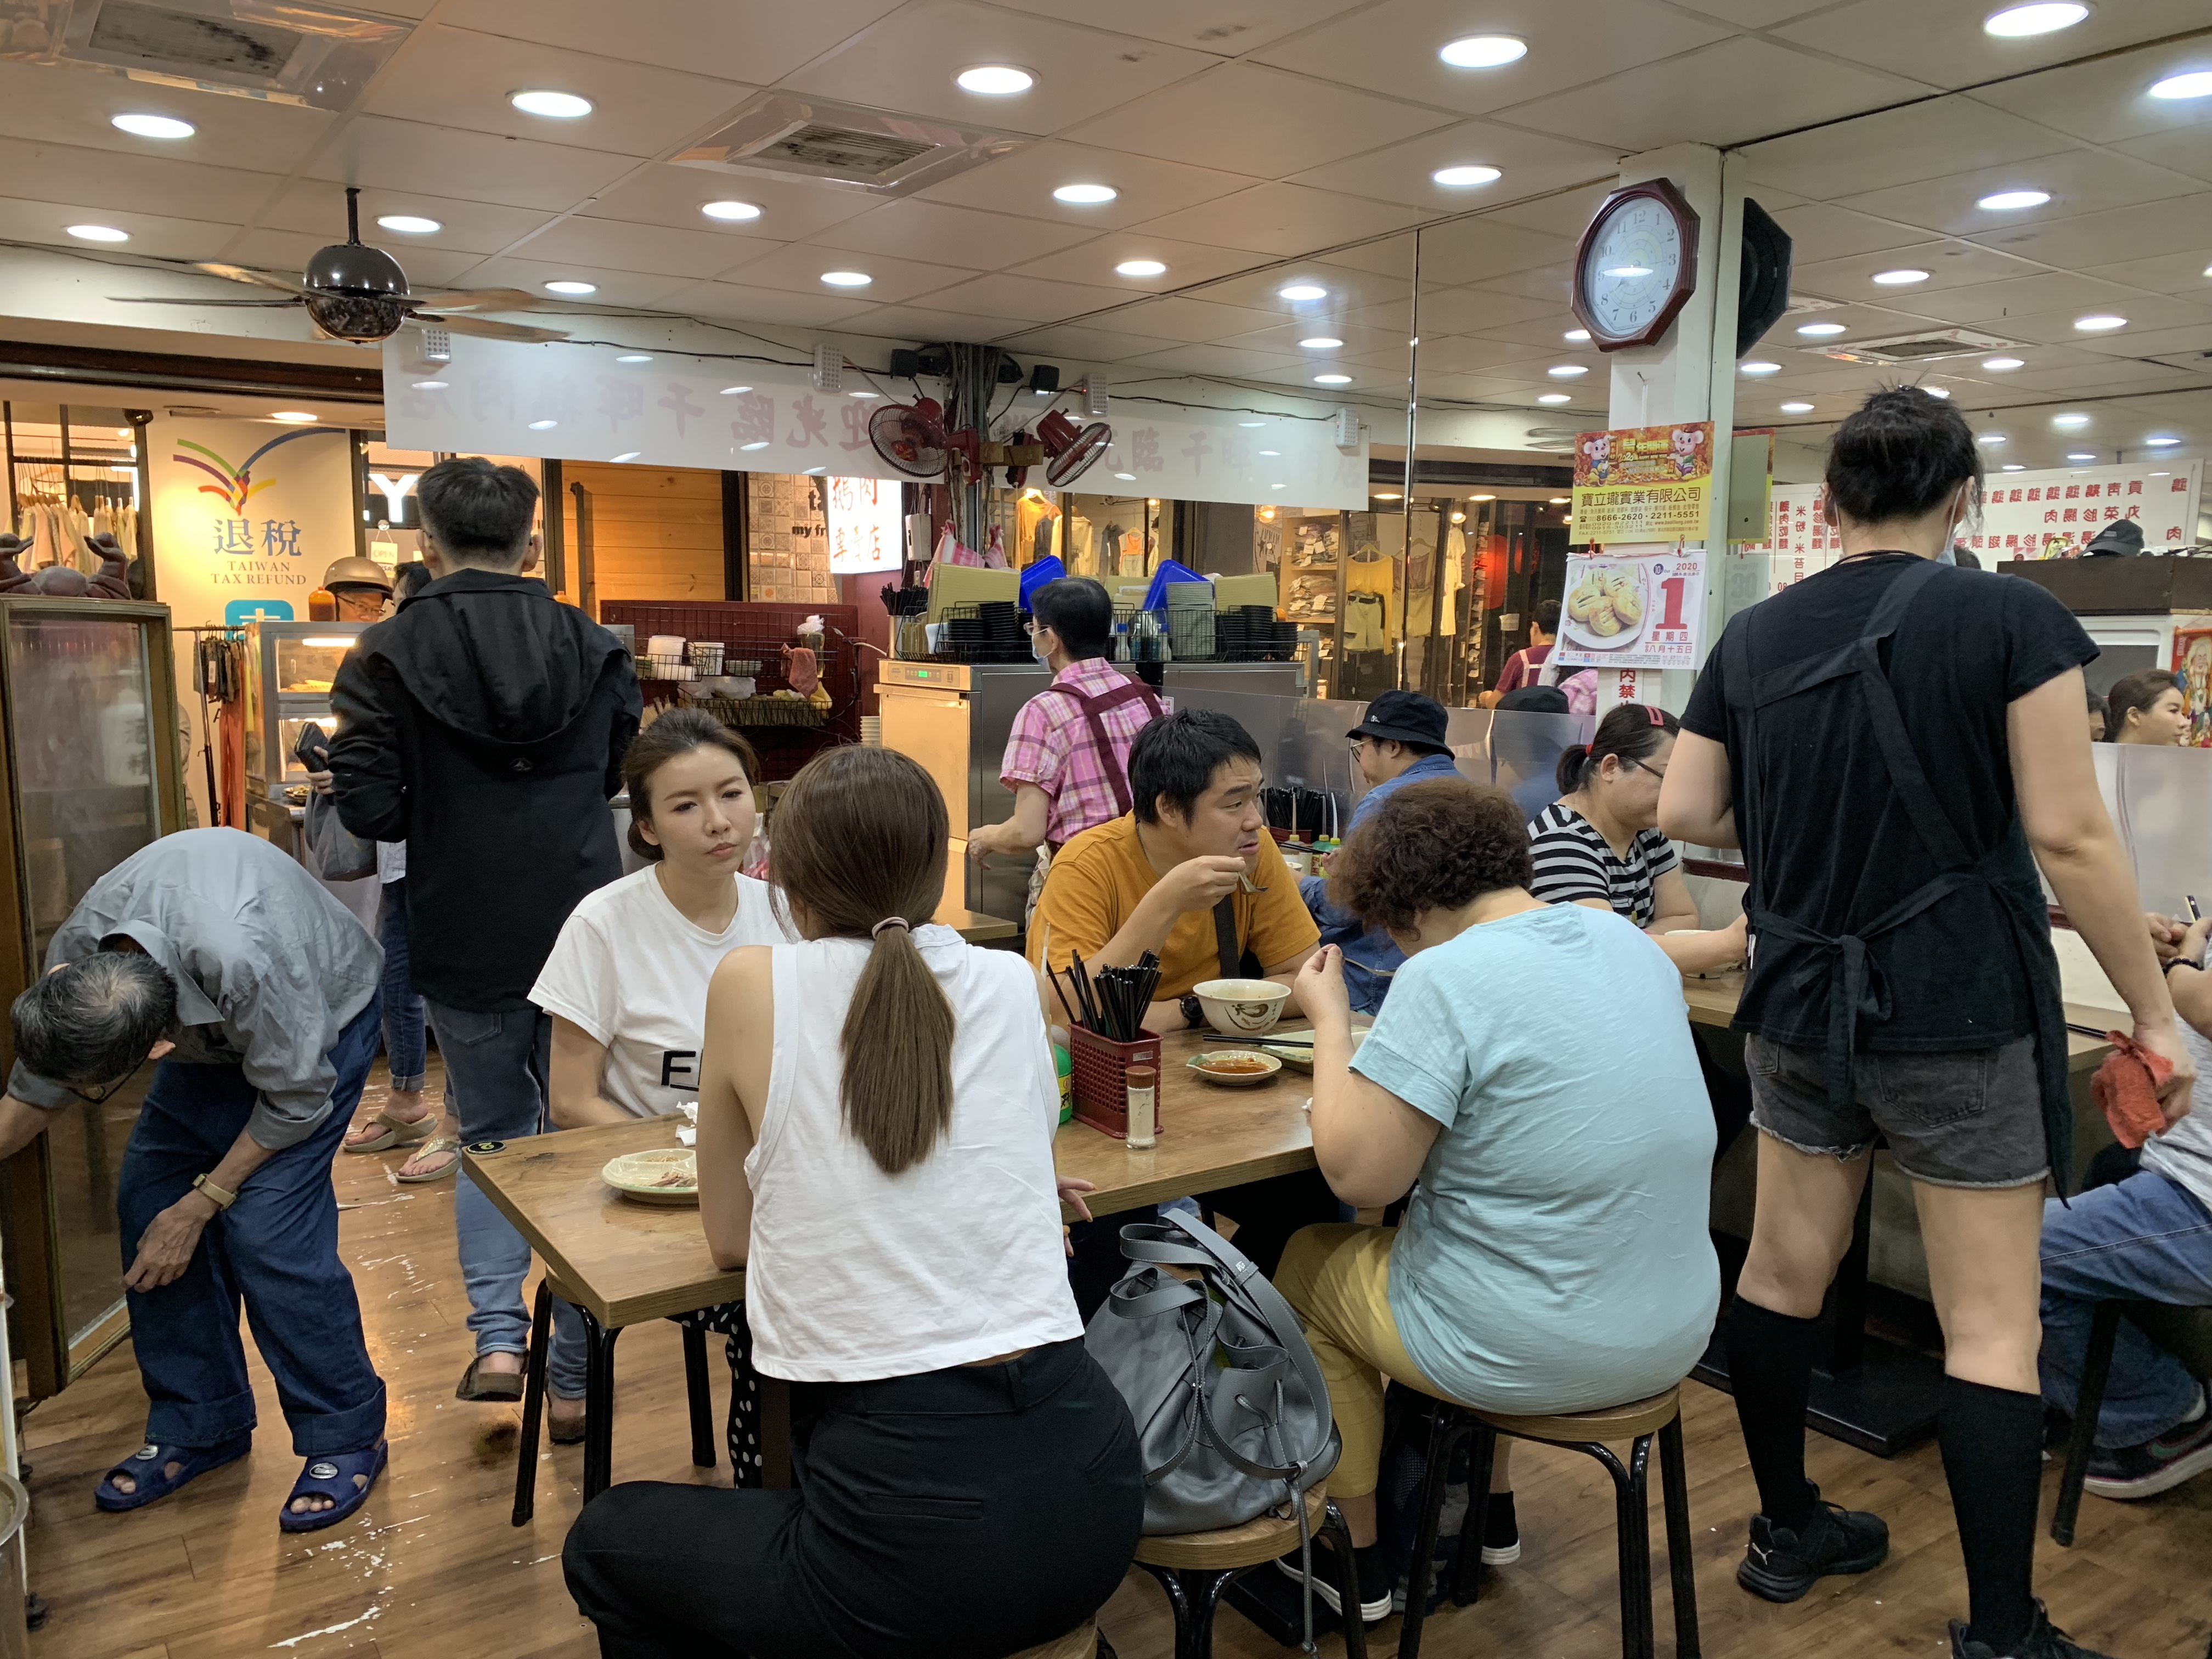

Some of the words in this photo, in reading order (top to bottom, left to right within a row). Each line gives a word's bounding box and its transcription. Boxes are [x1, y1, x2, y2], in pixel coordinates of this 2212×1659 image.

[1633, 210, 1646, 224] 12
[1656, 213, 1660, 225] 1
[1617, 221, 1627, 234] 11
[1667, 228, 1675, 242] 2
[1602, 245, 1612, 258] 10
[1668, 253, 1676, 266] 3
[1662, 278, 1670, 290] 4
[1601, 293, 1609, 306] 8
[1648, 300, 1656, 313] 5
[1612, 308, 1619, 321] 7
[1629, 311, 1637, 323] 6
[369, 473, 419, 522] Y
[1650, 511, 1699, 520] 2211-5551
[213, 518, 302, 556] 退稅
[792, 525, 812, 538] my
[227, 561, 290, 572] TAIWAN
[1676, 562, 1698, 571] 2020
[211, 573, 242, 584] TAX
[246, 574, 307, 585] REFUND
[1655, 577, 1688, 630] 1
[1651, 631, 1689, 642] 星期四
[661, 1048, 703, 1092] E
